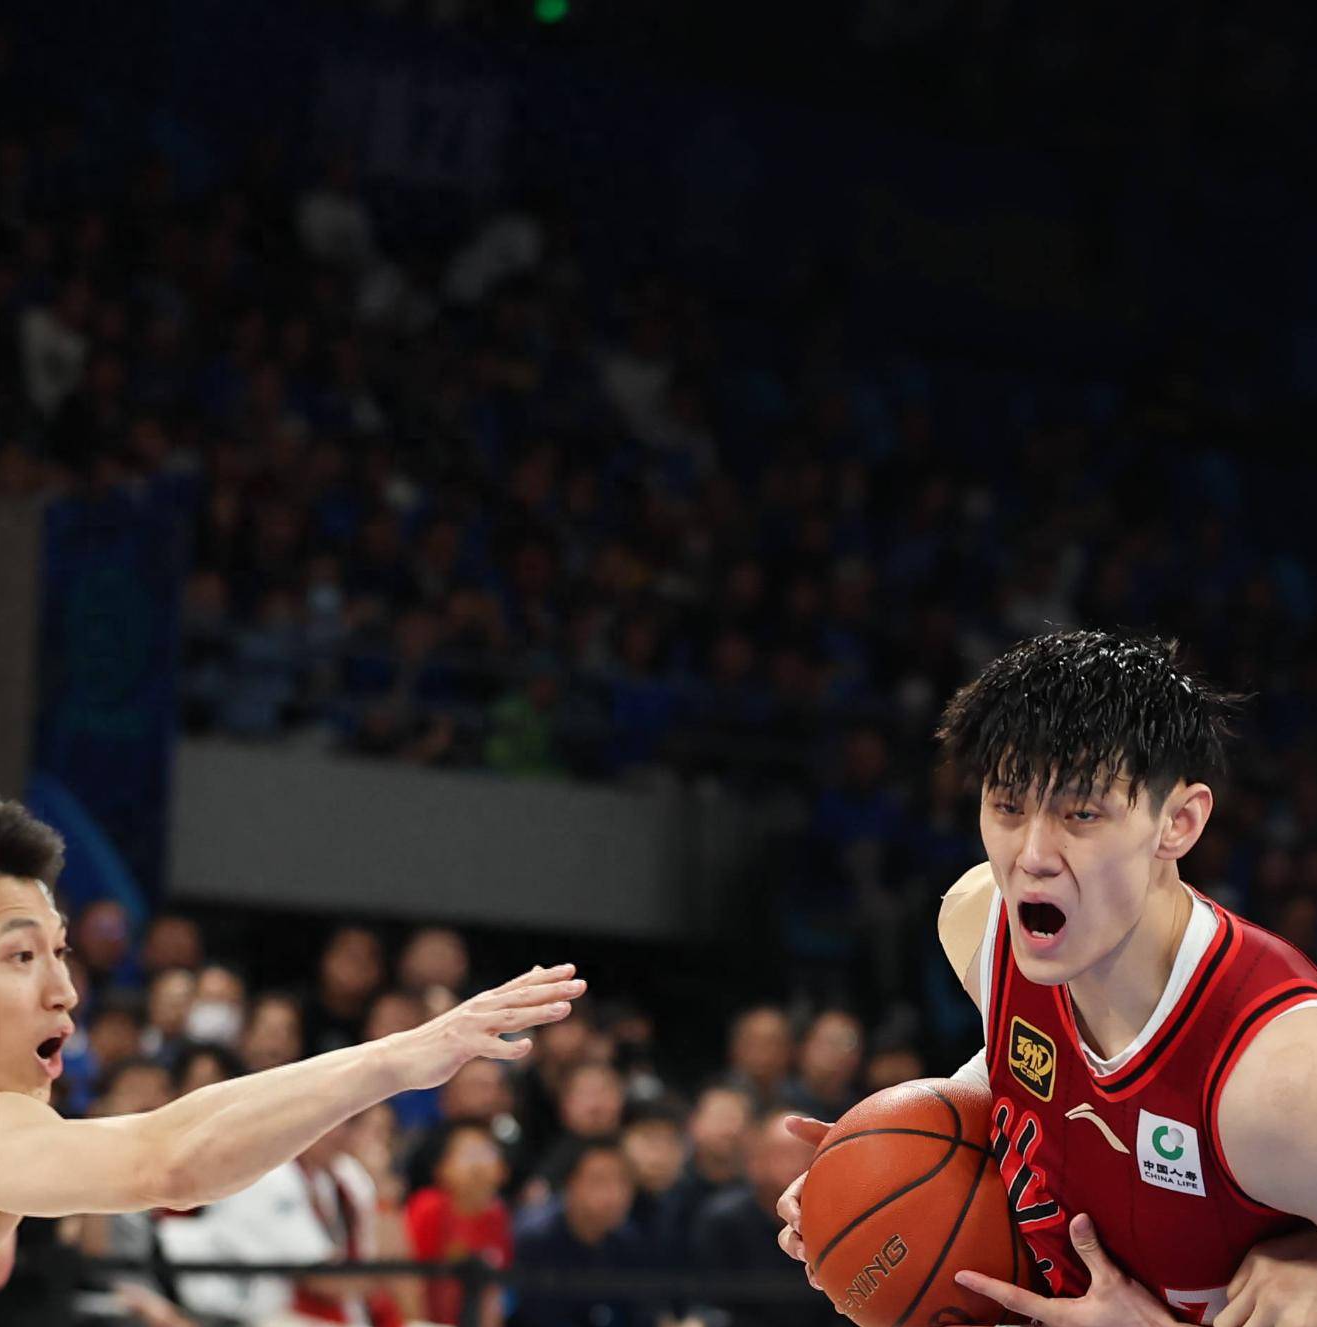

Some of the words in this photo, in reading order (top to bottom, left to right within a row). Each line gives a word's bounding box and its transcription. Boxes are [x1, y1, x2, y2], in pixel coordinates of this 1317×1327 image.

[1143, 1160, 1197, 1181] 中国人寿
[1145, 1171, 1174, 1184] CHINA
[1177, 1180, 1198, 1190] LIFE
